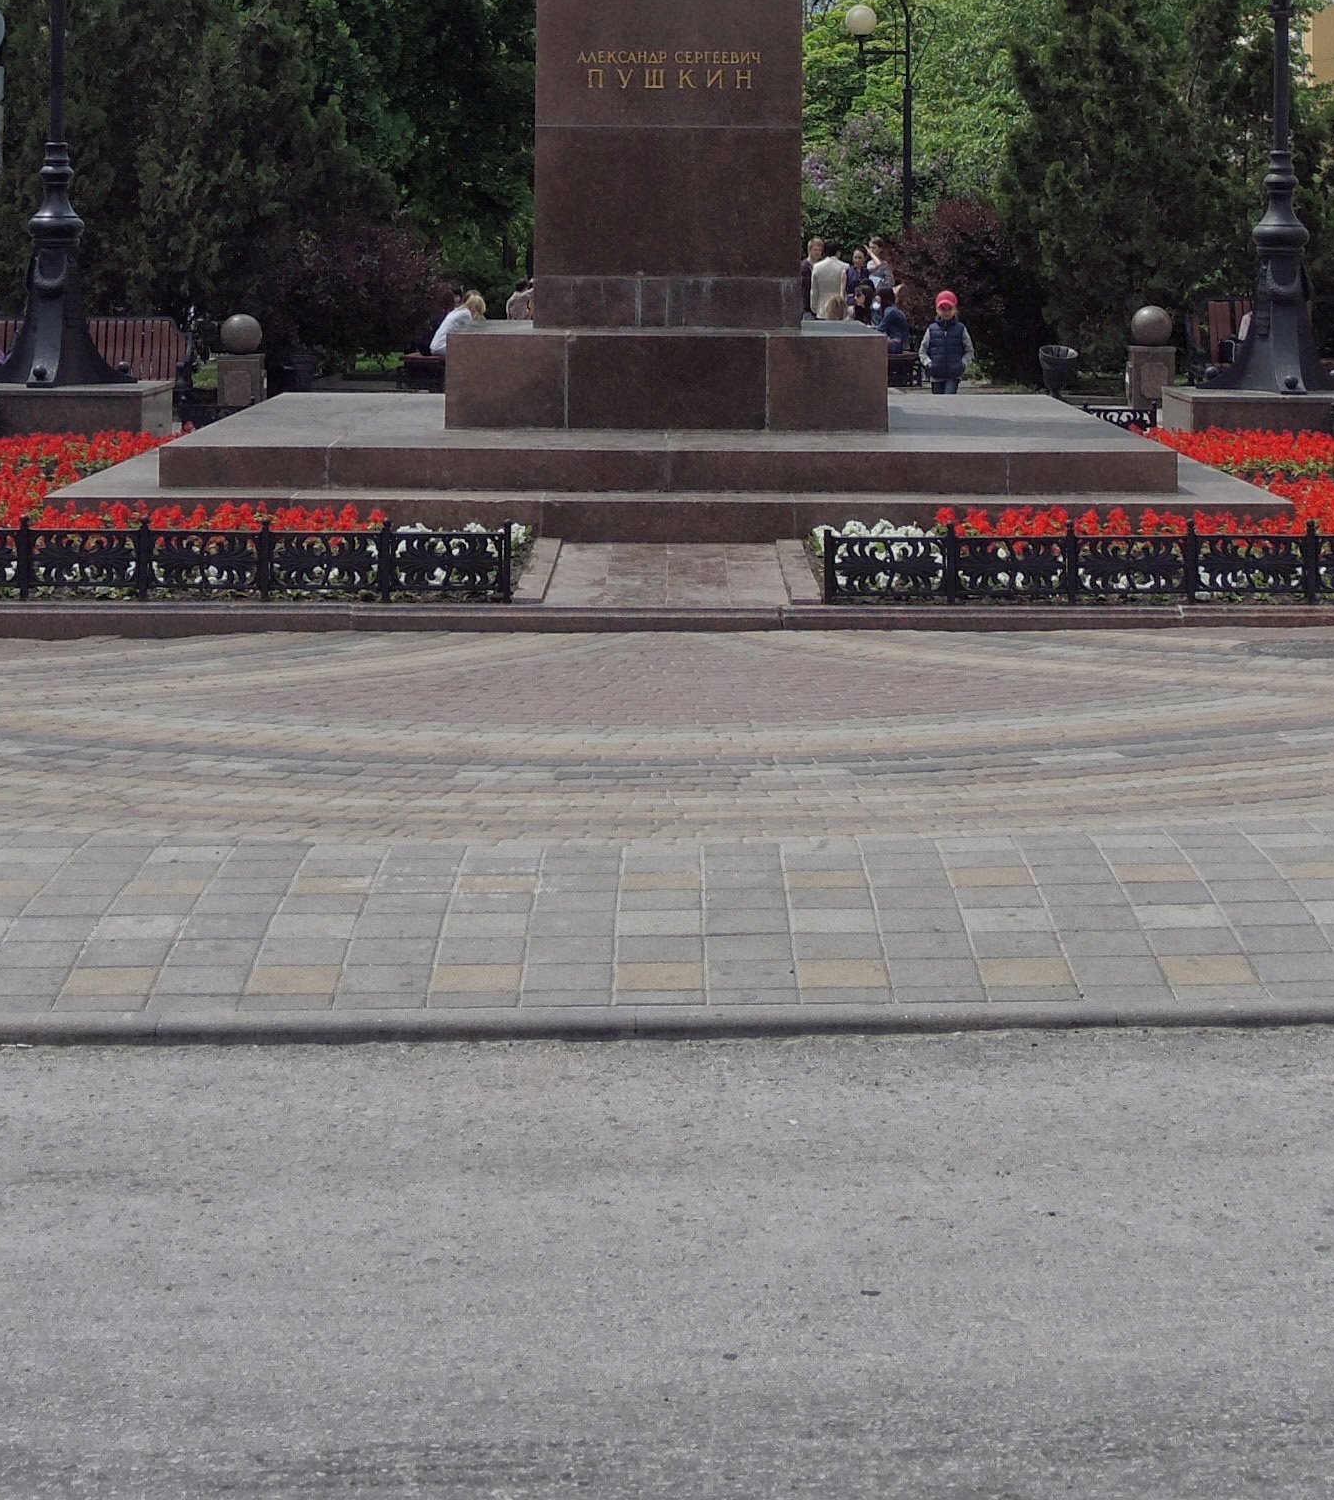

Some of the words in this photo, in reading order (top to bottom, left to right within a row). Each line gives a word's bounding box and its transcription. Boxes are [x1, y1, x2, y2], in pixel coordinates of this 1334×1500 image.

[576, 51, 667, 64] АЛЕКСАНДР
[674, 51, 761, 64] СЕРГЕЕВИЧ
[587, 69, 753, 89] ПУШКИН
